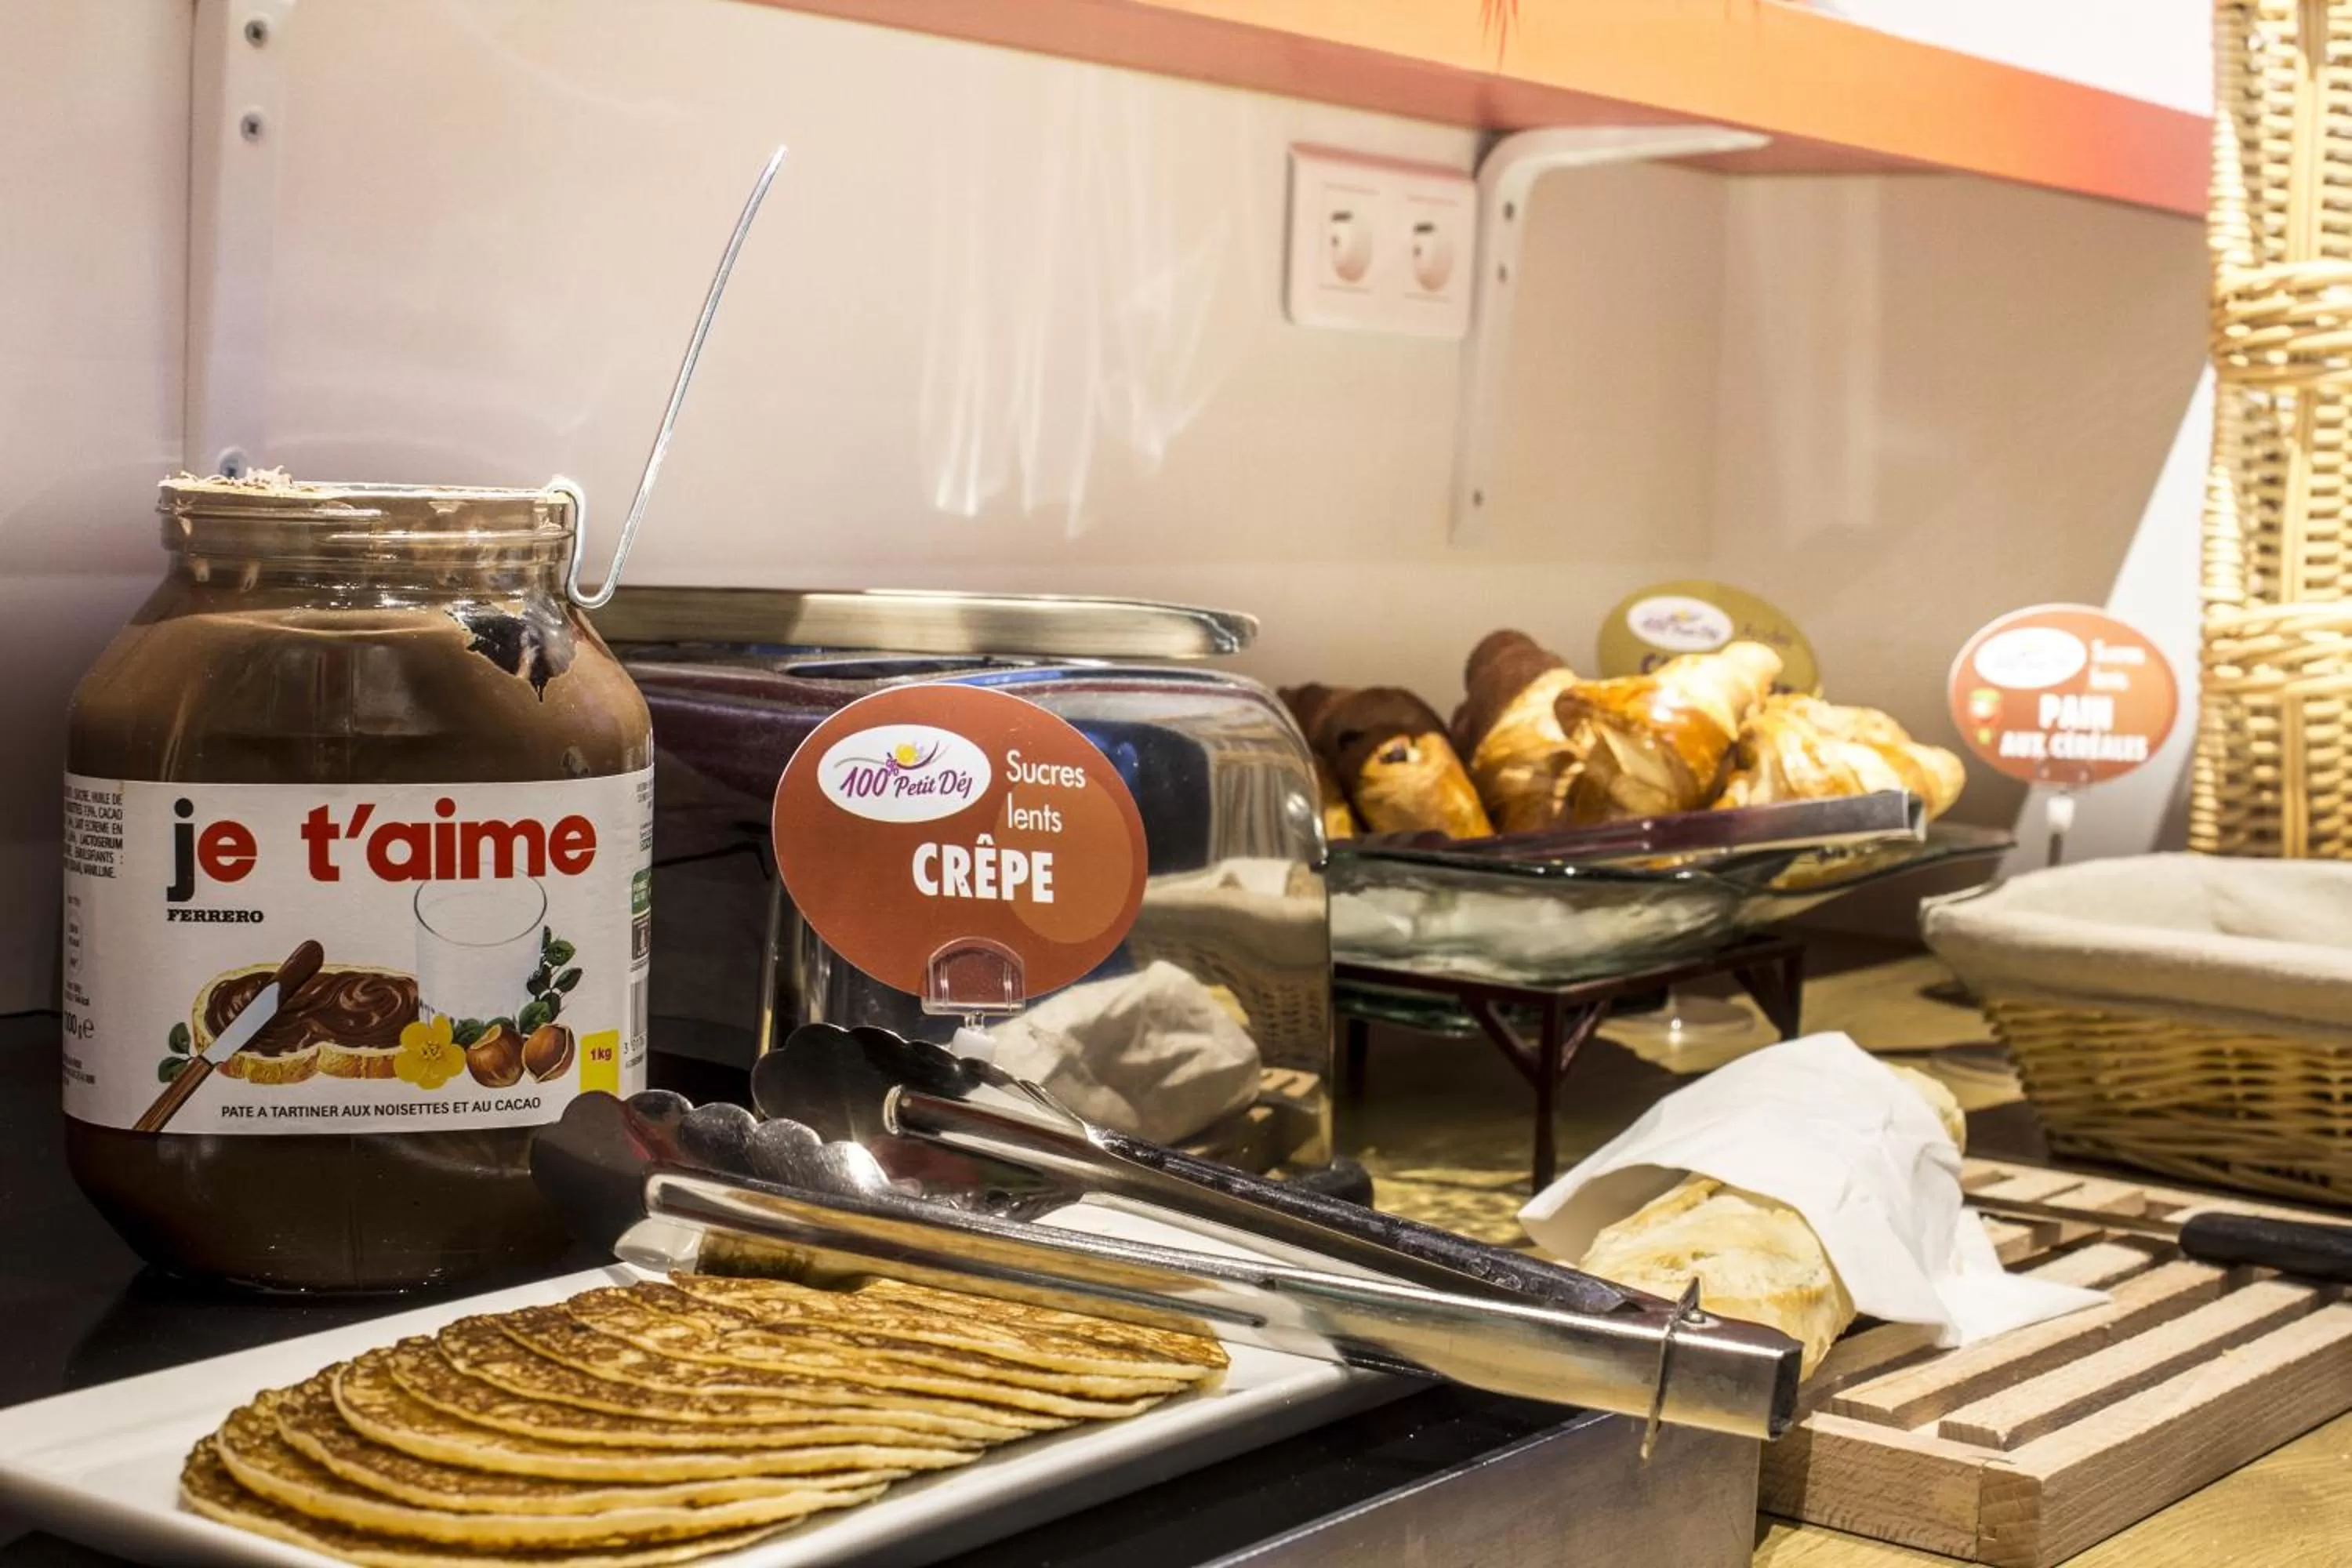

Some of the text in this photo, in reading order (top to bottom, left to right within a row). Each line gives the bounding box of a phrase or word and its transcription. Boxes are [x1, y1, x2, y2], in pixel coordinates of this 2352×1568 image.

[2041, 695, 2113, 729] PAIN
[894, 773, 937, 798] Petit
[938, 769, 973, 799] Déj
[1006, 749, 1086, 789] Sucres
[1006, 793, 1063, 833] lents
[166, 797, 597, 902] je t'aime
[912, 833, 1055, 904] CRÊPE
[166, 908, 265, 924] FERRERO
[221, 1105, 255, 1118] PATE
[270, 1105, 339, 1118] TARTINER
[342, 1104, 371, 1117] AUX
[374, 1102, 450, 1116] NOISETTES
[452, 1100, 470, 1113] ET
[472, 1098, 492, 1112] AU
[495, 1096, 542, 1112] CACAO
